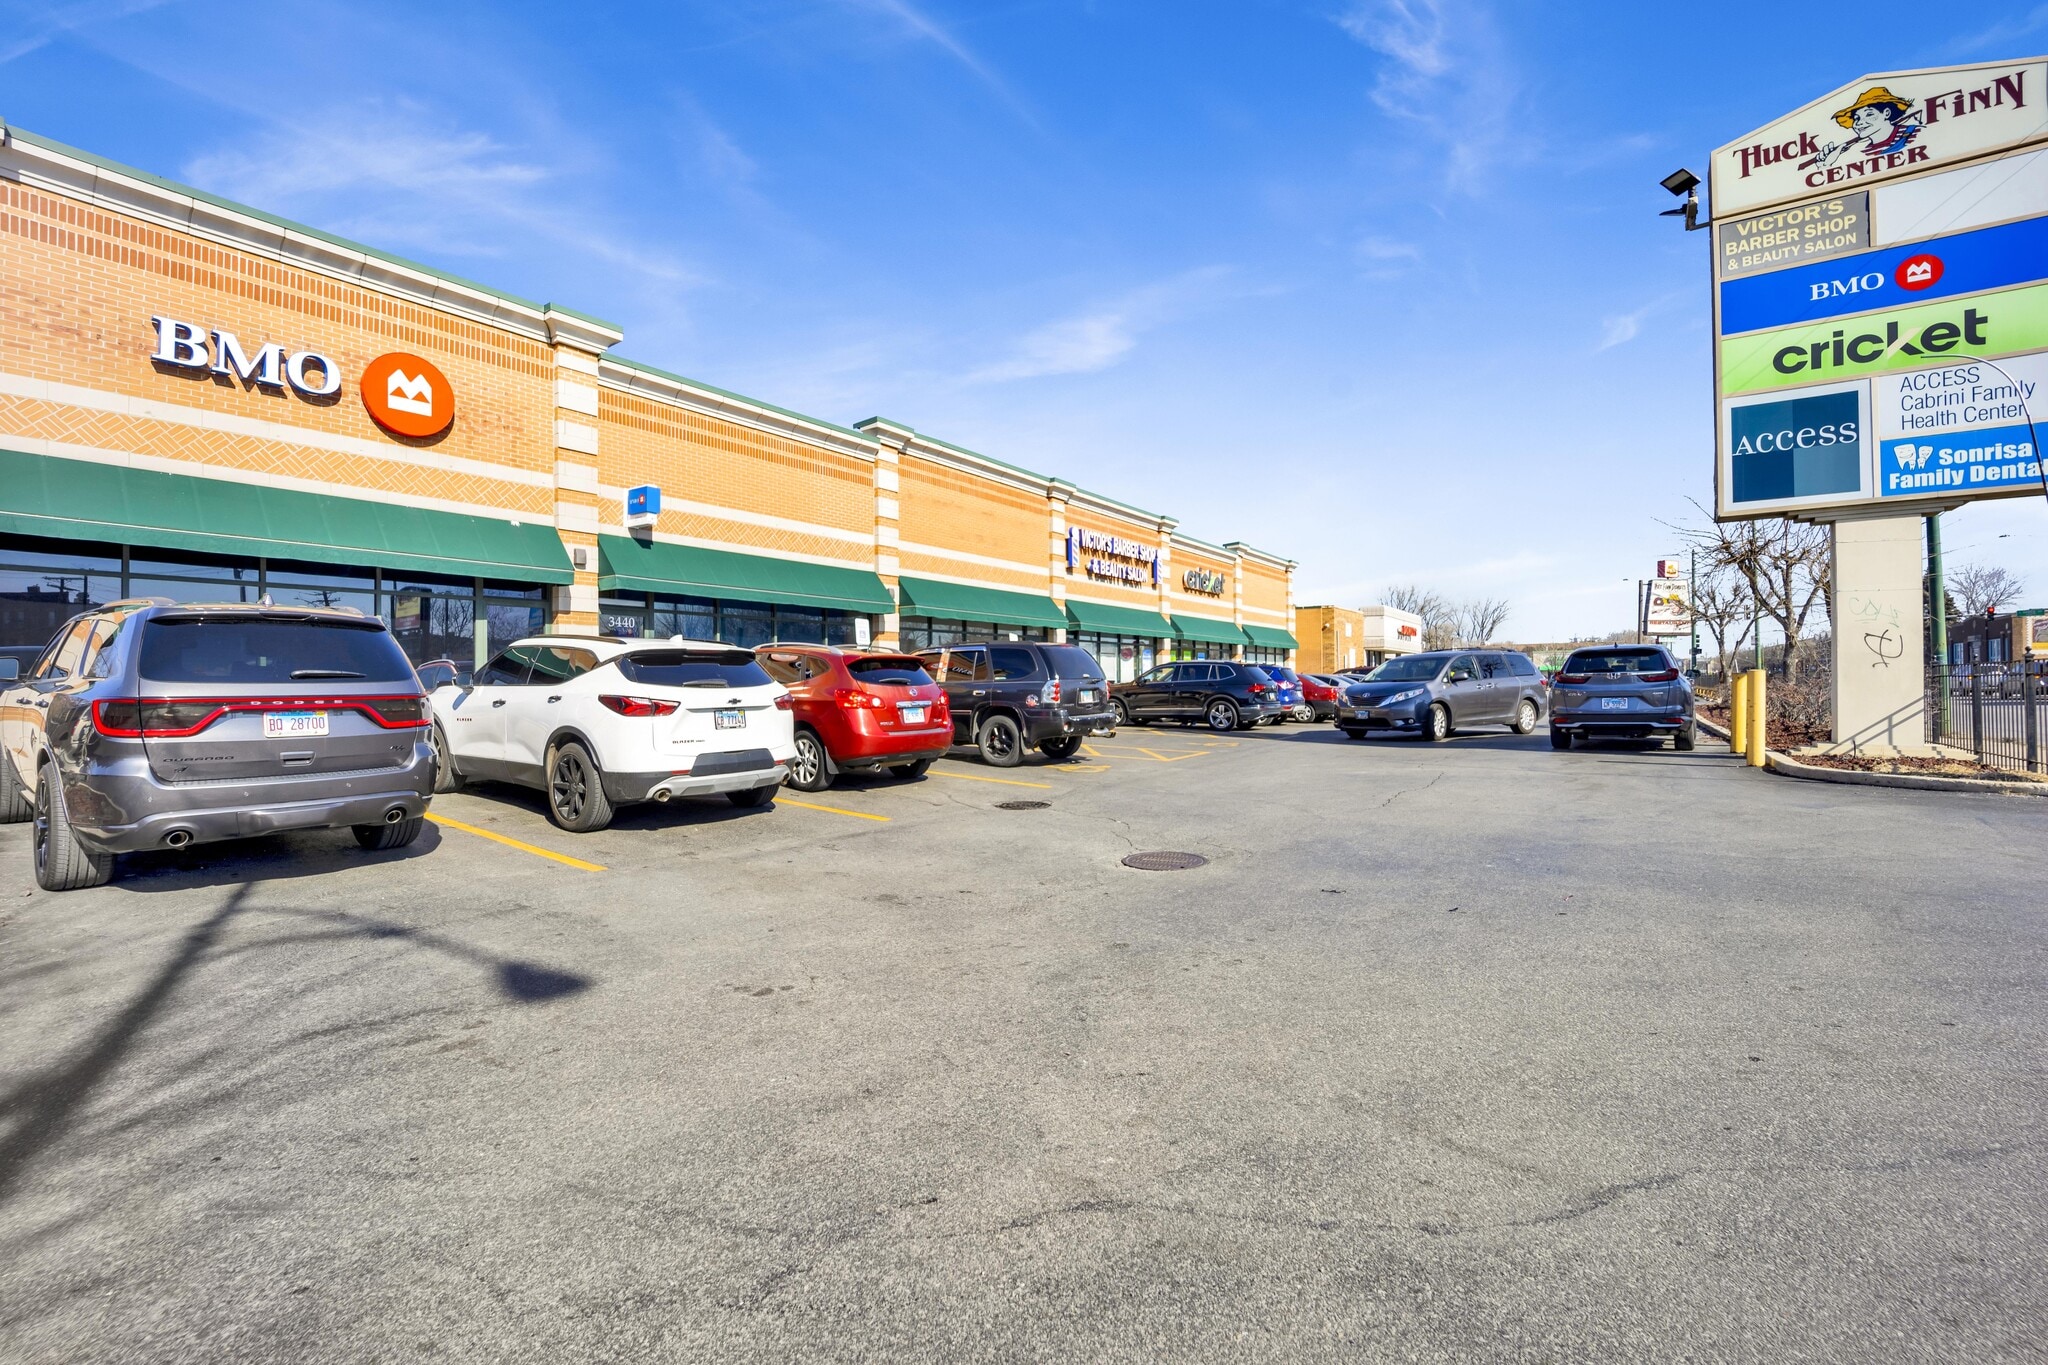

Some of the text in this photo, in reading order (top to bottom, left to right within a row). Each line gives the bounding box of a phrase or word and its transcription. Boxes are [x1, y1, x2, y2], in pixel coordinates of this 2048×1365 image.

[1805, 144, 1930, 188] CENTER
[1736, 200, 1844, 236] VICTOR'S
[1725, 214, 1857, 256] BARBER SHOP
[1727, 232, 1857, 271] & BEAUTY SALON
[1809, 273, 1885, 301] BMO
[151, 314, 341, 397] BMO
[1773, 308, 1988, 374] cricket
[1900, 366, 1980, 393] ACCESS
[1901, 379, 2036, 412] Cabrini Family
[1901, 403, 2025, 430] Health Center
[1938, 442, 2033, 466] Sonrisa
[1889, 458, 2048, 490] Family Dental
[1081, 529, 1156, 563] VICTOR'S BARBER SHOP
[1093, 559, 1147, 583] & BEAUTY SALON
[1184, 567, 1225, 594] cricket
[608, 616, 635, 628] 3440
[291, 717, 325, 731] 28700
[163, 755, 234, 763] DURANGO
